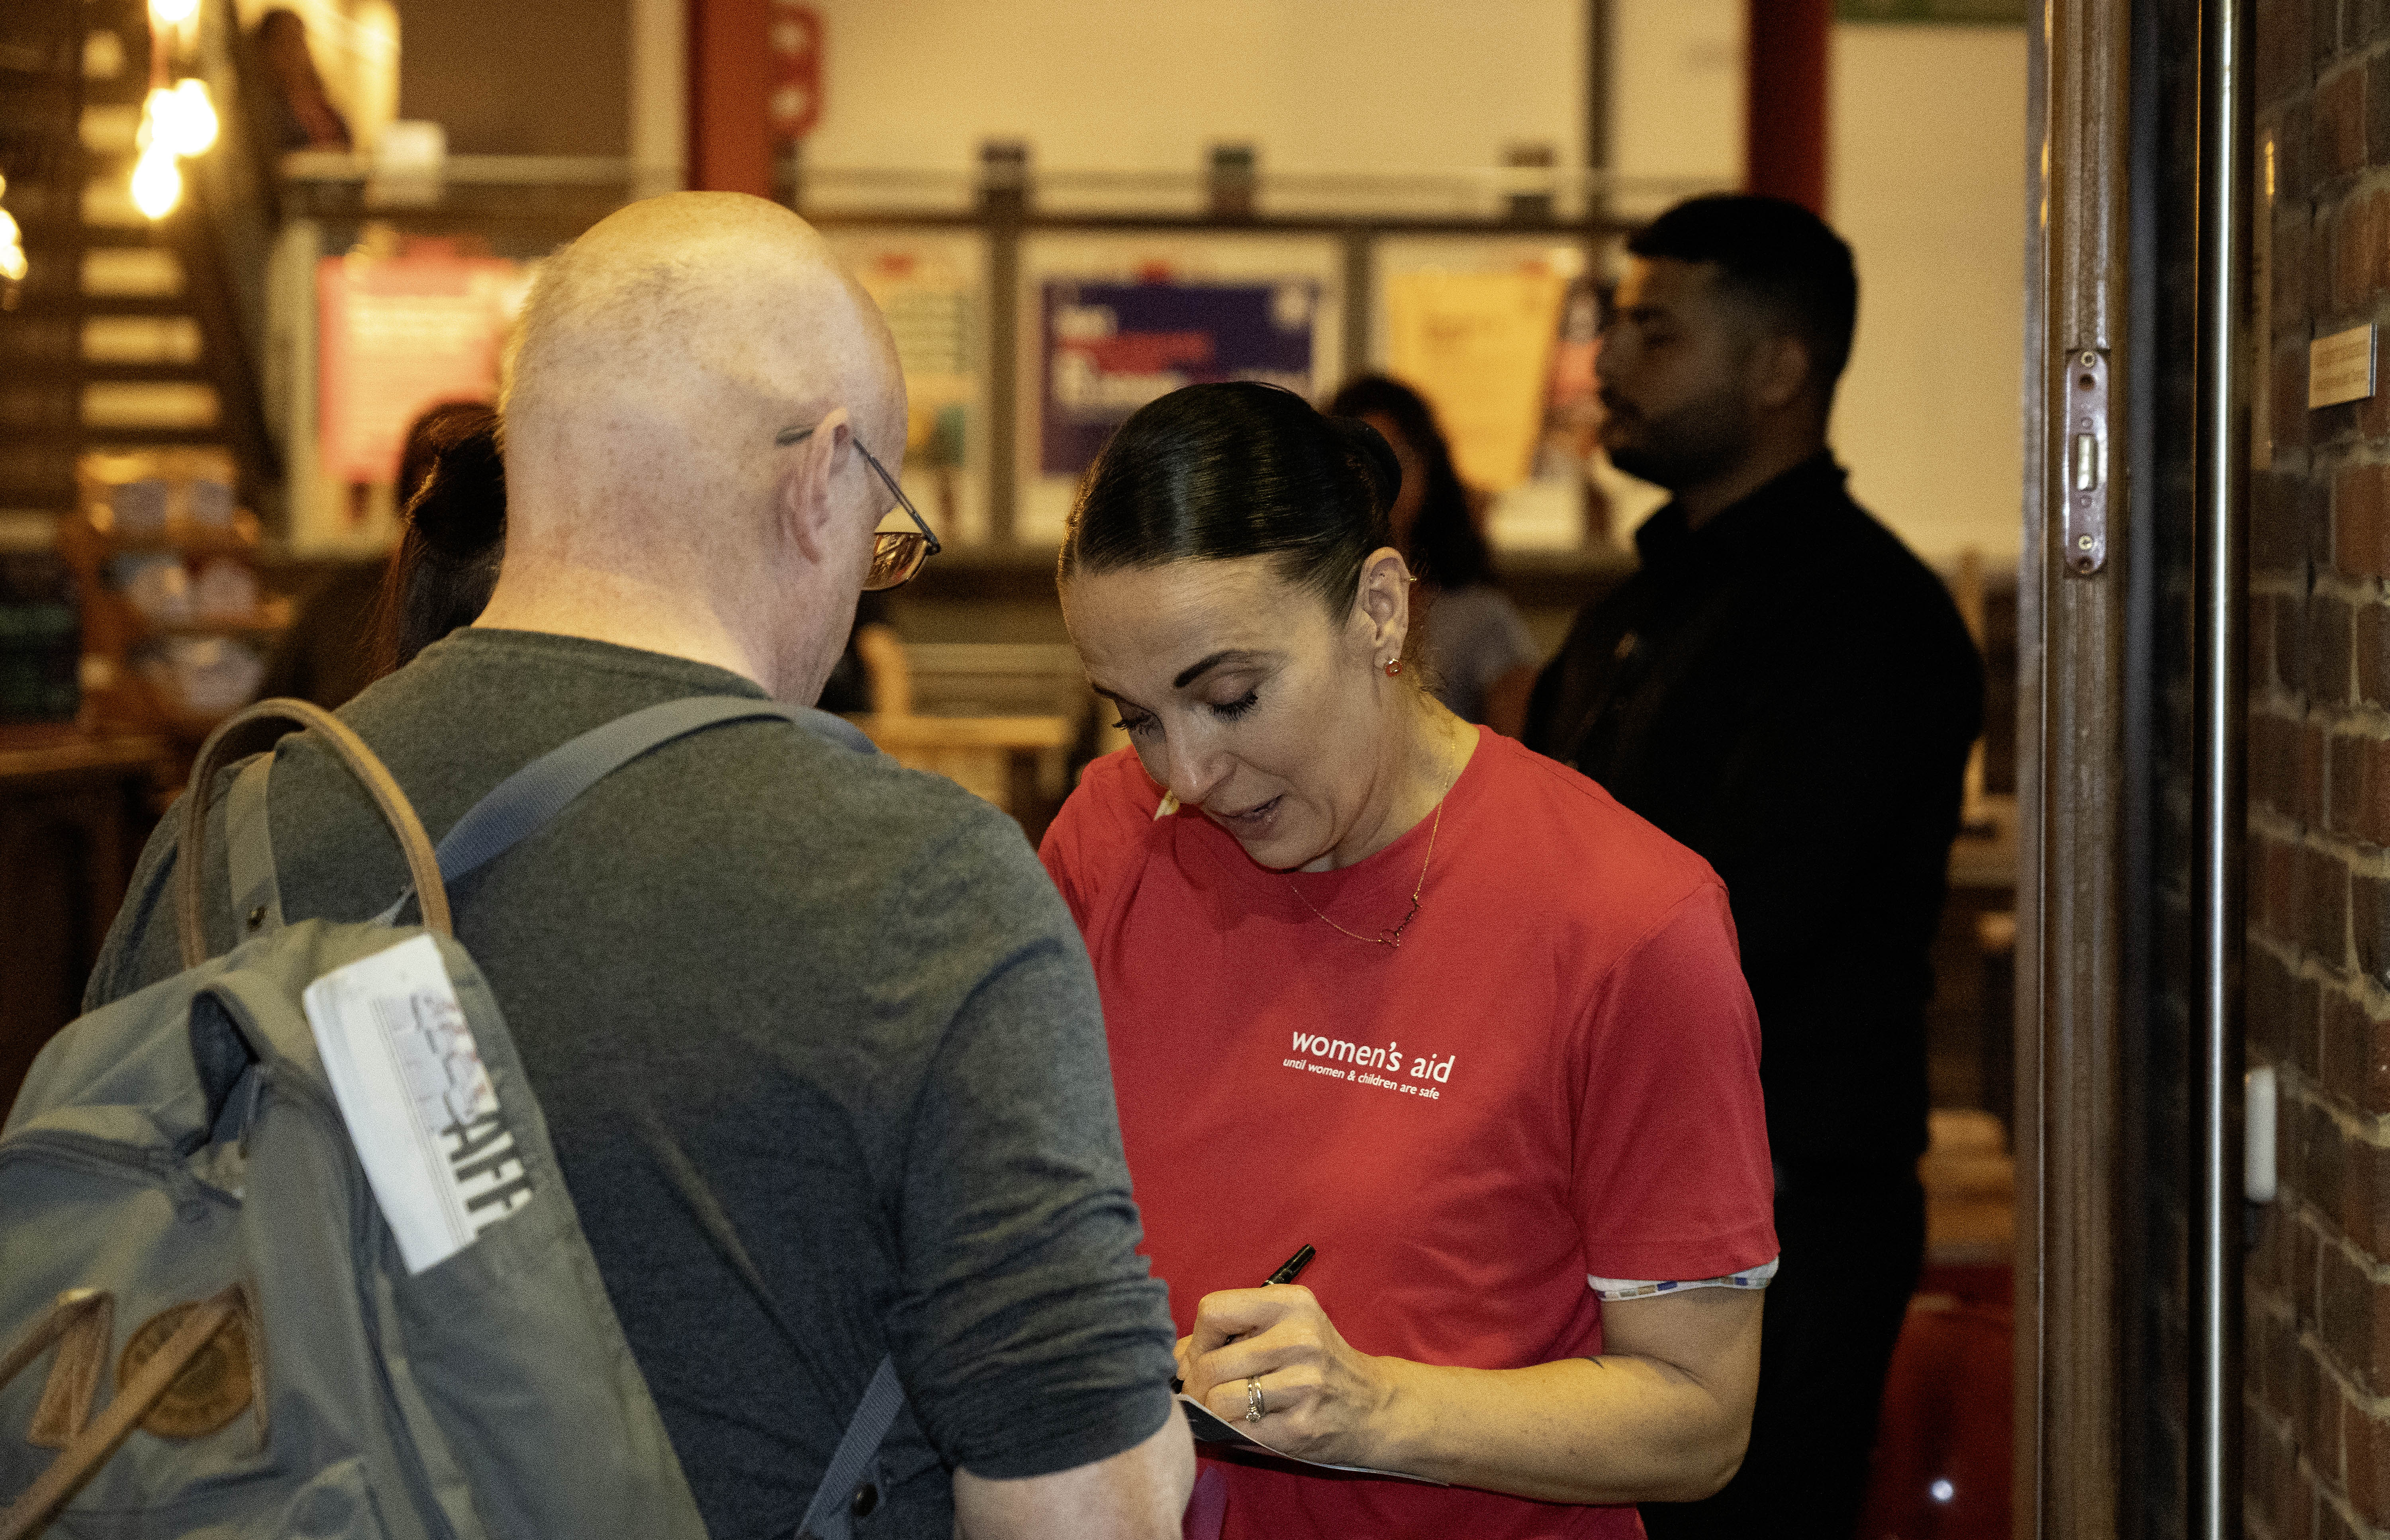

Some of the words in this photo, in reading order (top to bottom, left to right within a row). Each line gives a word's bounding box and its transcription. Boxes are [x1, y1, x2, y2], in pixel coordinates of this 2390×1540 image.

[1283, 1058, 1307, 1070] until
[1308, 1063, 1346, 1079] women
[1346, 1070, 1356, 1082] &
[1358, 1072, 1398, 1091] children
[1399, 1084, 1418, 1095] are
[1418, 1086, 1440, 1100] safe
[1410, 1053, 1456, 1083] aid
